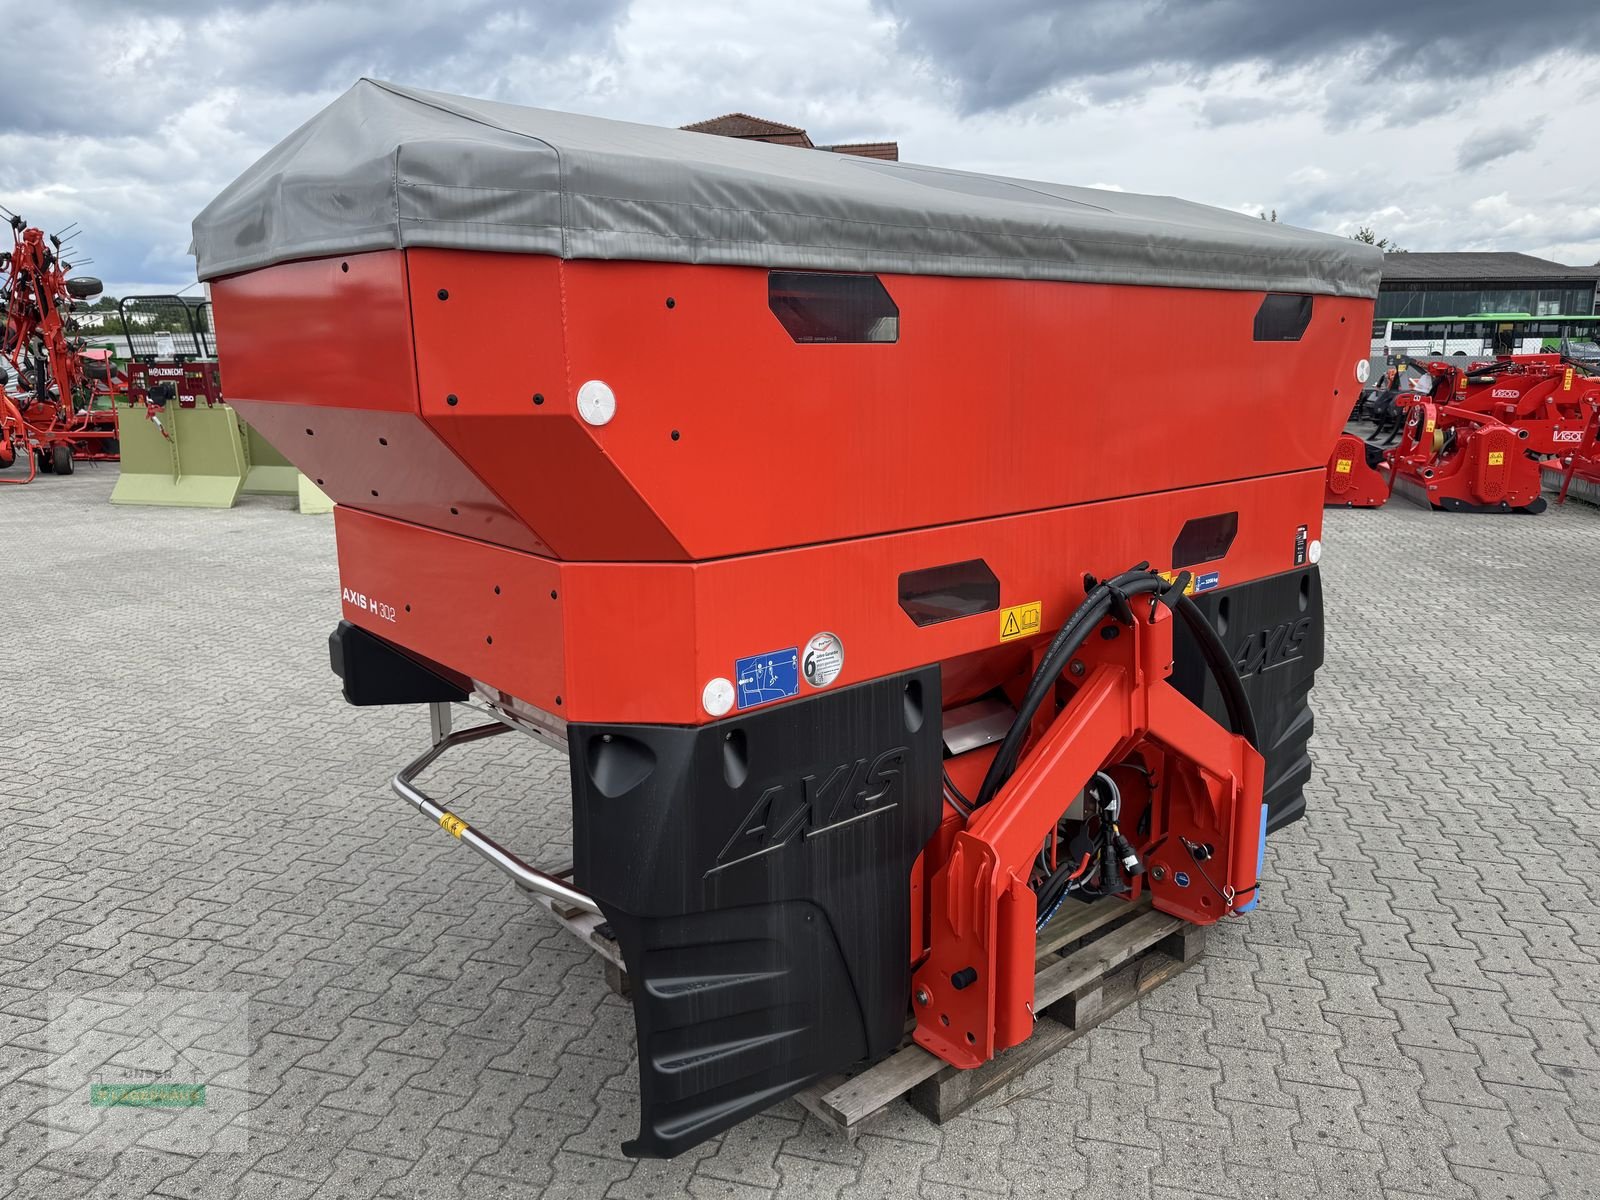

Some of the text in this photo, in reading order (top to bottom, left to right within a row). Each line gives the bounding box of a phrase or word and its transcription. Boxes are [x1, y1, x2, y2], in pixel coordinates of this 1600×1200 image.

[1491, 389, 1520, 398] VIGOLO
[342, 587, 397, 623] AXIS H 302
[1233, 616, 1312, 674] AXIS
[804, 650, 816, 678] 6
[716, 746, 910, 862] AXIS
